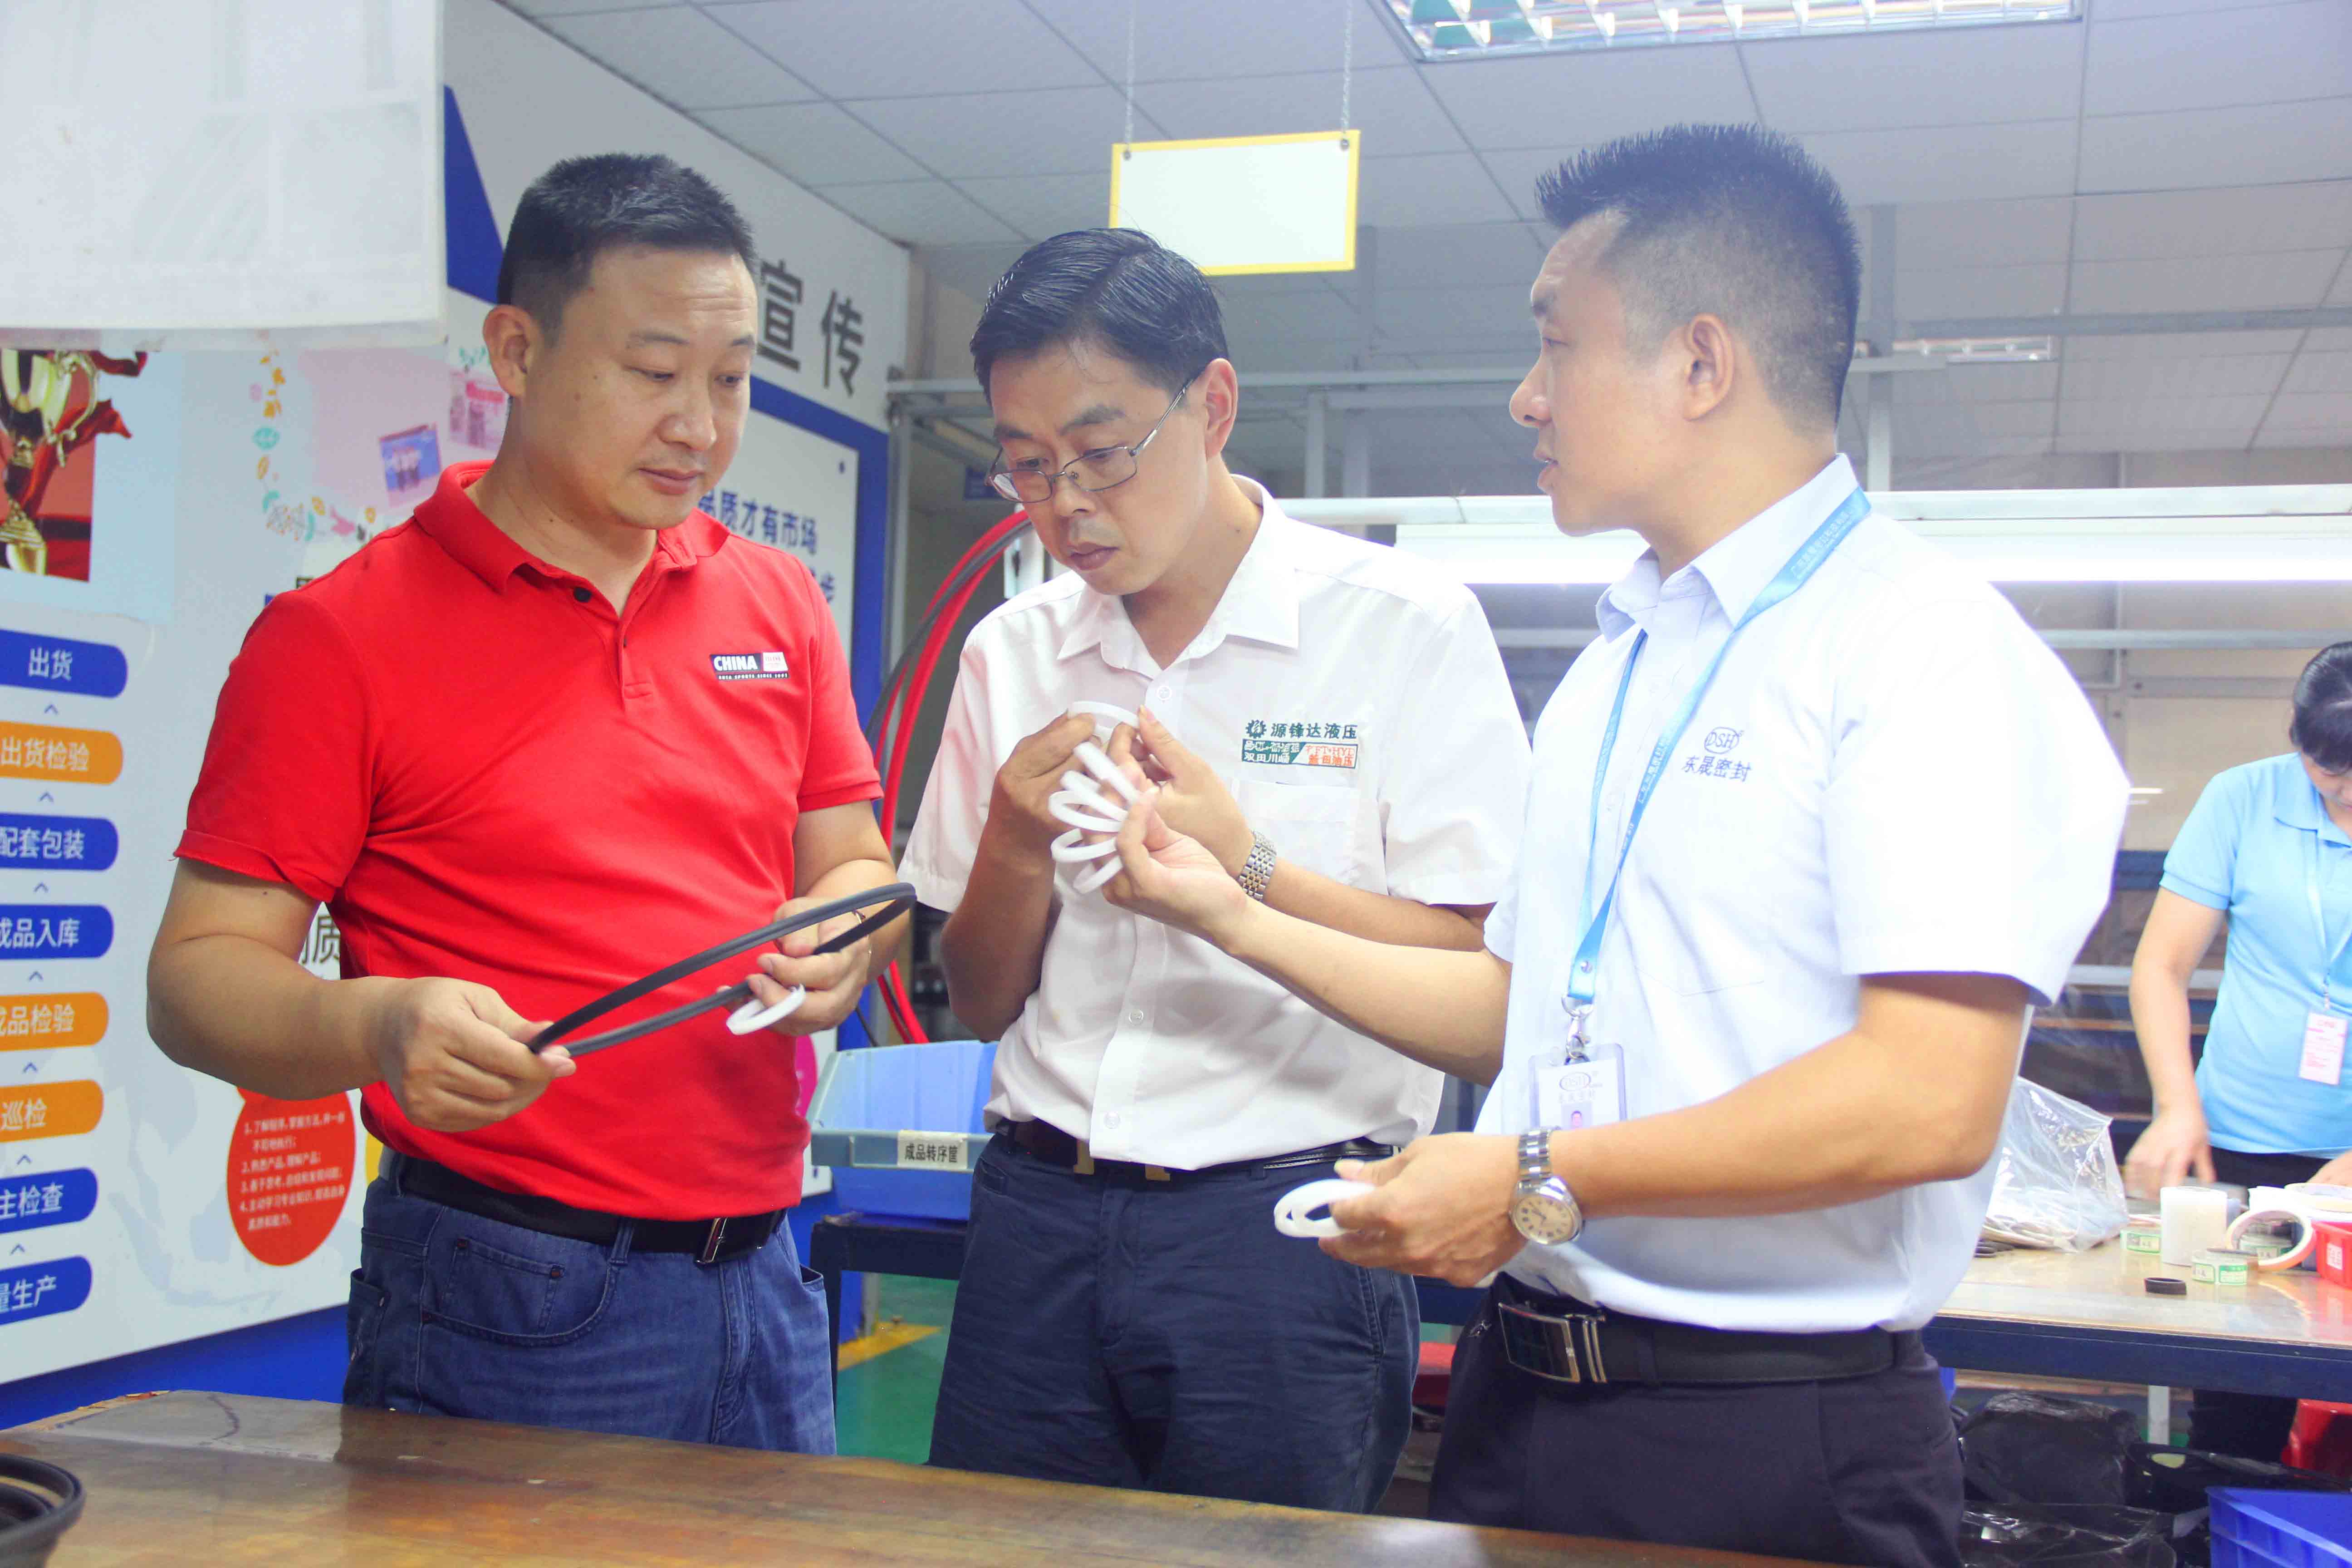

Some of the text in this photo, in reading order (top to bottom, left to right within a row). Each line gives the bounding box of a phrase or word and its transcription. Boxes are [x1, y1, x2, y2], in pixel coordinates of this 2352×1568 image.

[28, 647, 73, 680] 出货
[714, 656, 758, 671] CHINA
[0, 736, 90, 772] 出货检验
[0, 826, 85, 860] 配套包装
[1, 1097, 48, 1131] 巡检
